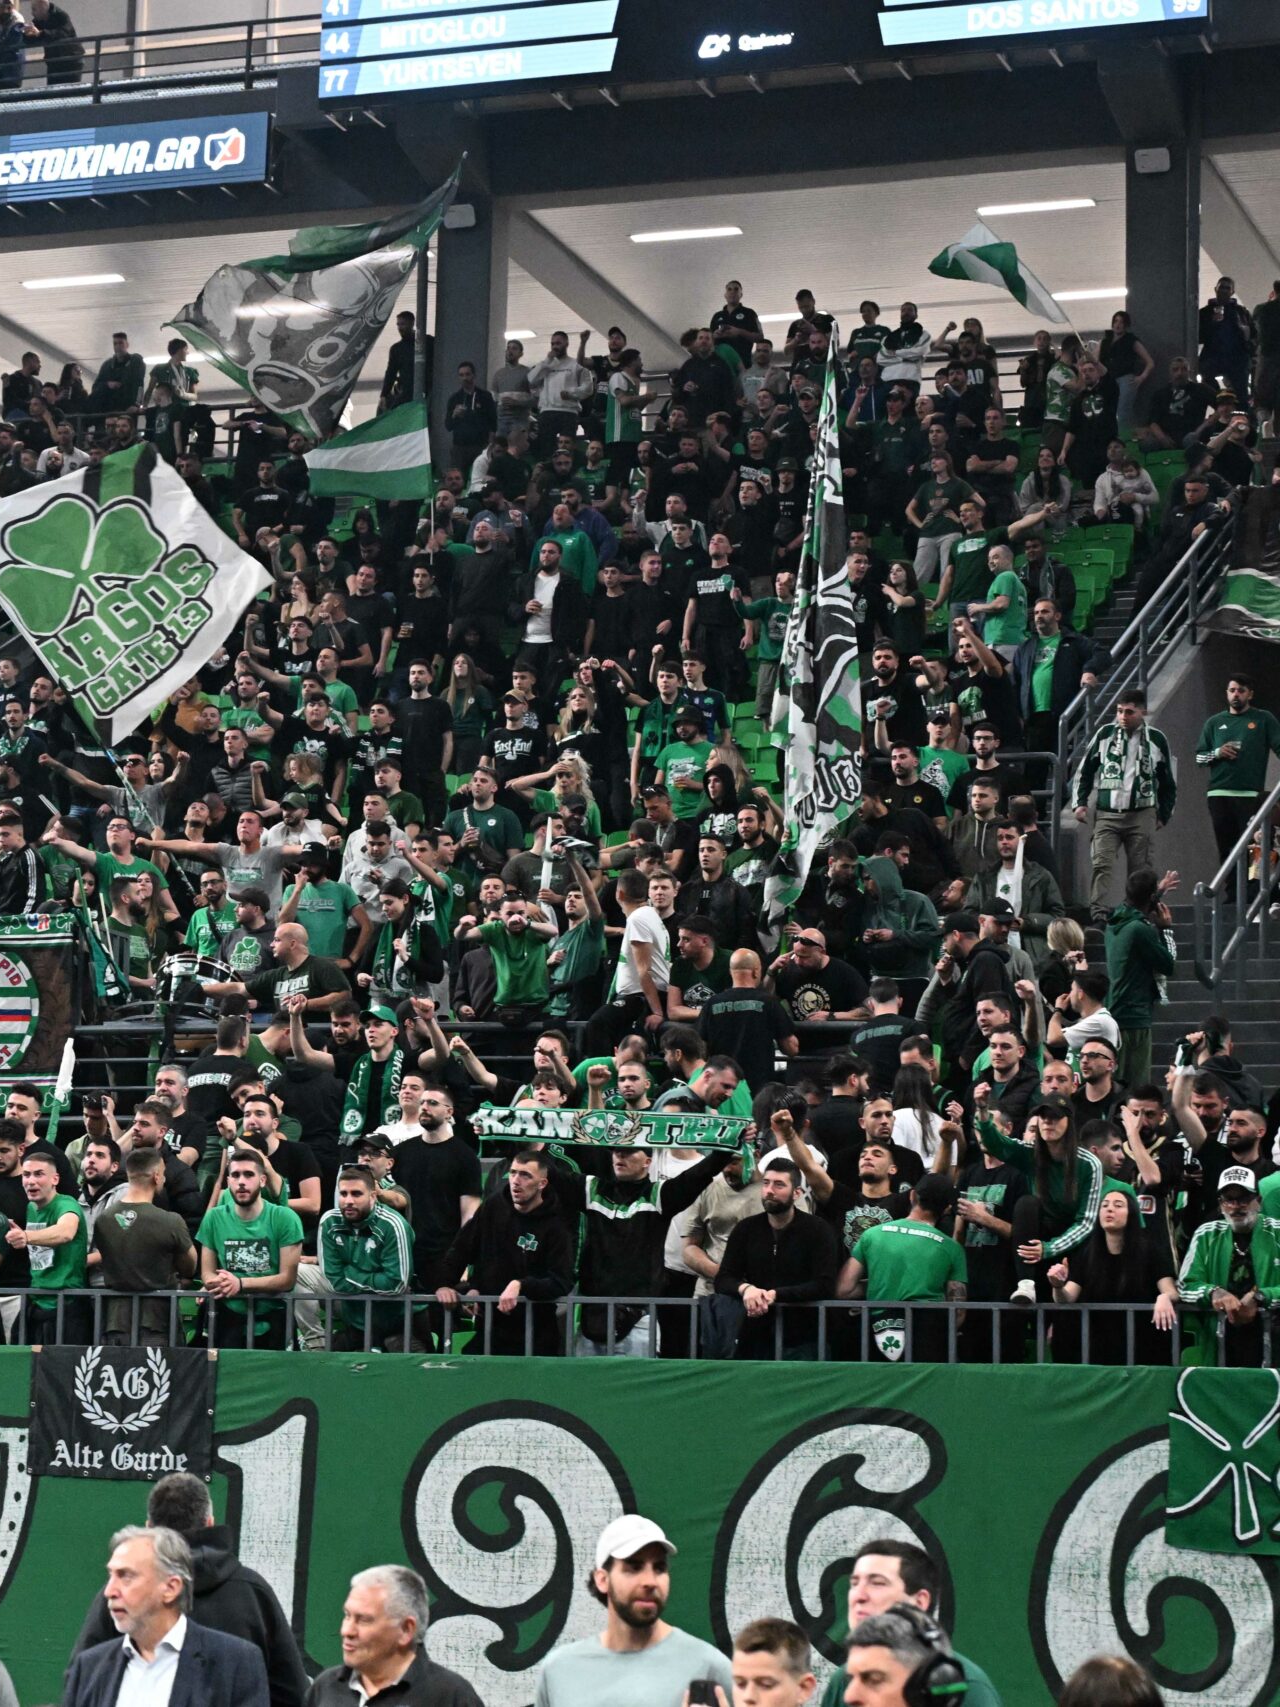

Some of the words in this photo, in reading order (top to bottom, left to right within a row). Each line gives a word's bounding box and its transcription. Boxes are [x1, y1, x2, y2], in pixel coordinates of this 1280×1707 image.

[966, 6, 1023, 31] DOS
[1030, 0, 1141, 26] SANTOS
[324, 32, 350, 55] 44
[380, 15, 506, 49] MITOGLOU
[324, 69, 349, 93] 77
[378, 51, 522, 87] YURTSEVEN
[37, 545, 216, 692] ARGOS
[86, 630, 180, 713] GATE
[163, 600, 212, 645] 13
[494, 739, 513, 751] East
[514, 737, 533, 750] End
[188, 1073, 214, 1088] GATE
[94, 1364, 150, 1400] AG
[49, 1439, 104, 1469] Alte
[111, 1442, 189, 1473] Garde
